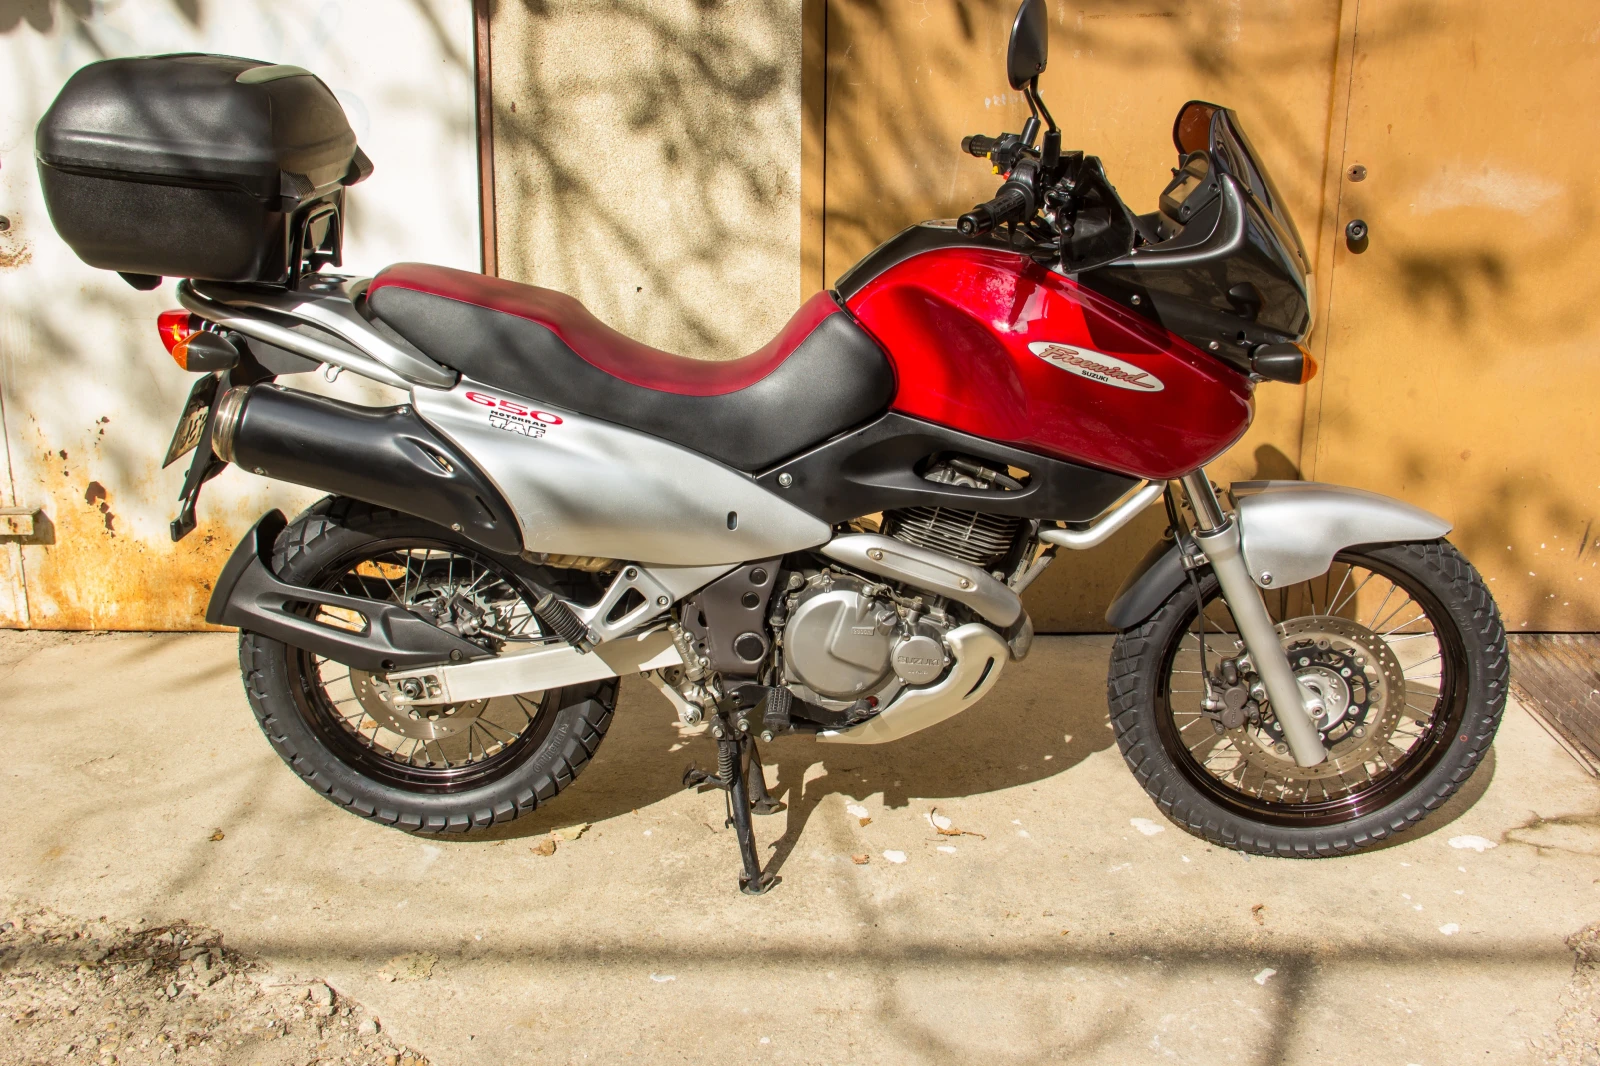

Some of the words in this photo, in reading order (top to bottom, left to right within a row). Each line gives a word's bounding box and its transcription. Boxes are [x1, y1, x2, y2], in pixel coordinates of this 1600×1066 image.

[1039, 344, 1155, 389] Freewind
[1081, 369, 1109, 383] SUZUKI
[465, 391, 563, 425] 650
[490, 410, 547, 428] MOTORRAD
[897, 655, 940, 667] SUZUKI
